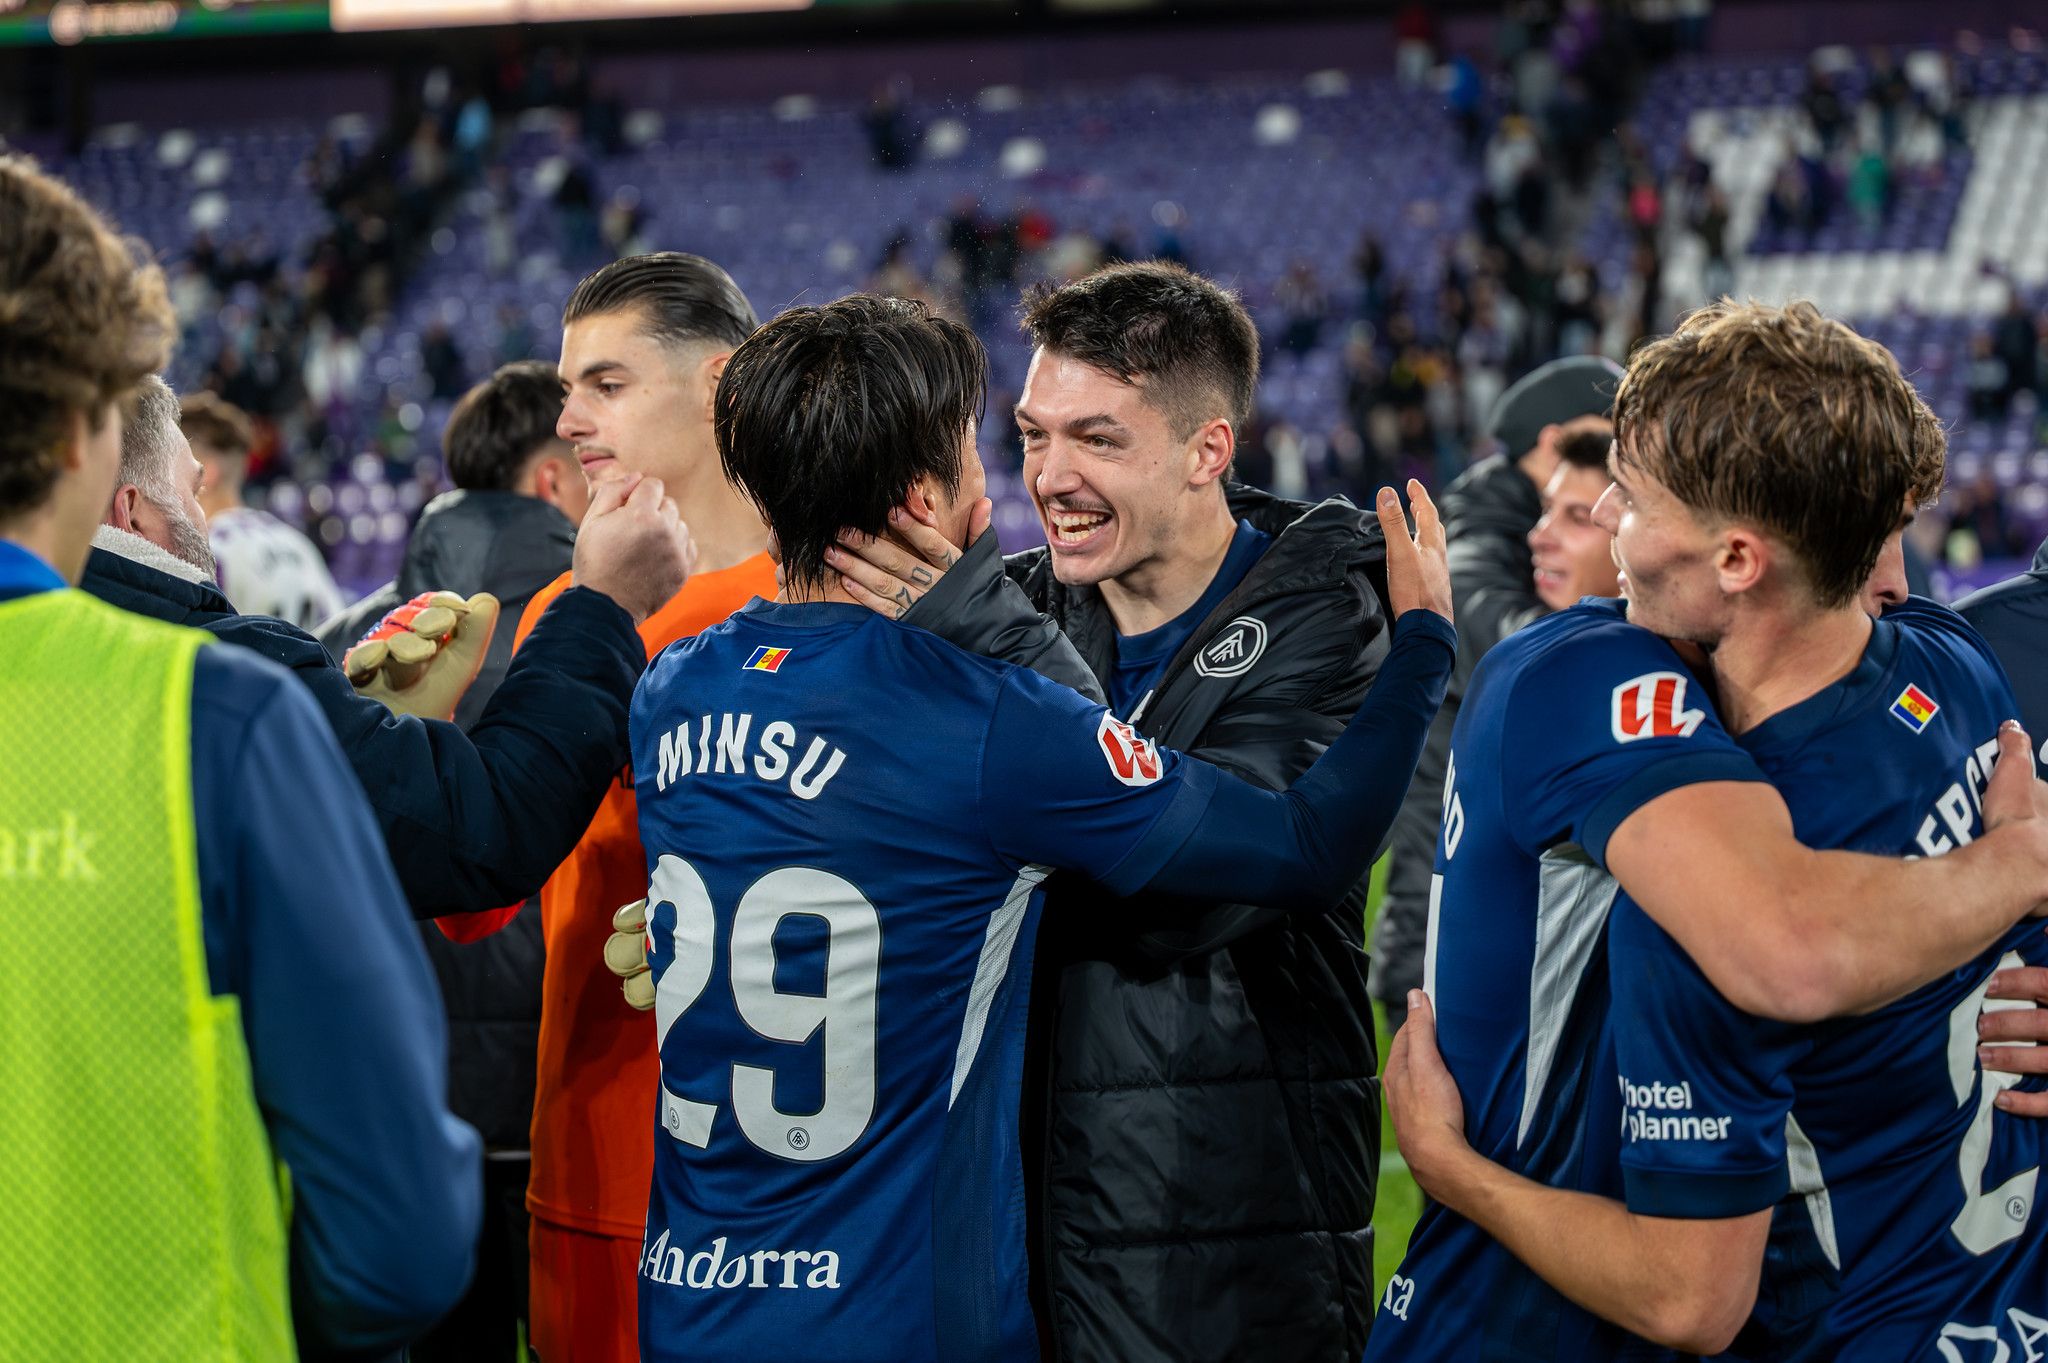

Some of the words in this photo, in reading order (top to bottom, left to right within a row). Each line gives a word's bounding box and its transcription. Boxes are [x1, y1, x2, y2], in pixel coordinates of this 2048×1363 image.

[657, 713, 847, 800] MINSU
[647, 853, 881, 1162] 29
[1625, 1078, 1693, 1110] hotel
[1628, 1109, 1732, 1143] planner
[644, 1228, 841, 1290] Andorra
